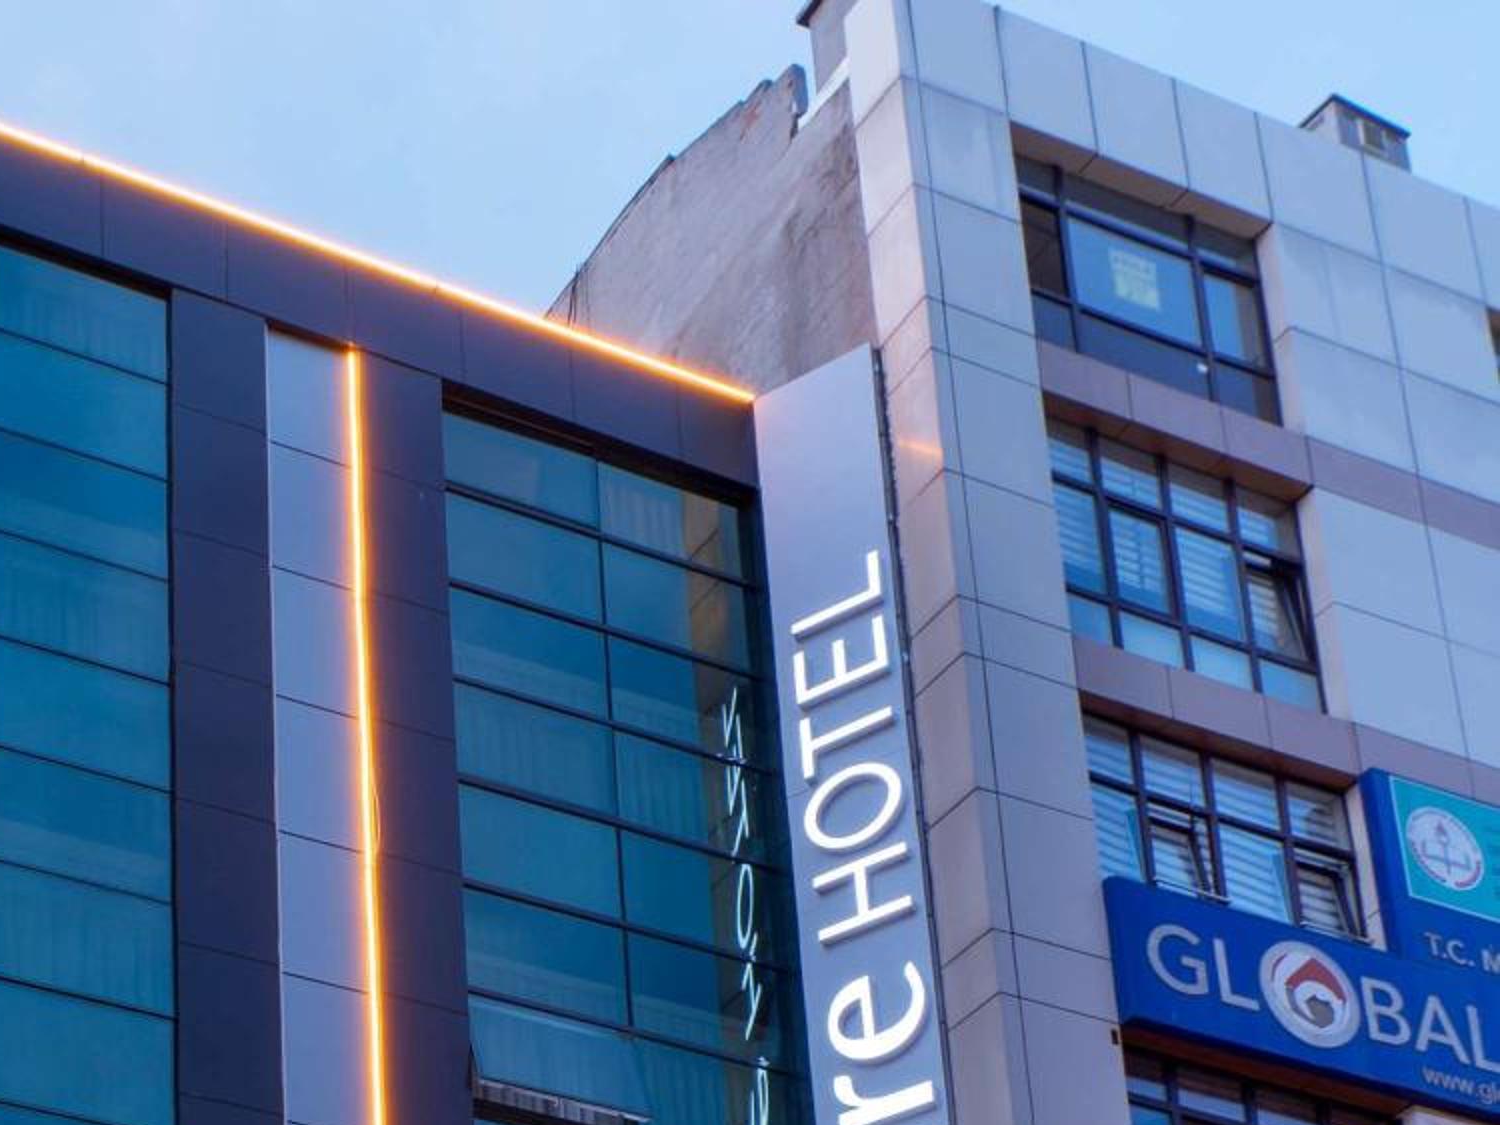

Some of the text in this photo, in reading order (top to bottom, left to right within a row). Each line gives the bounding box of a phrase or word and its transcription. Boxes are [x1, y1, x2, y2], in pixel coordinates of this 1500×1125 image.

[791, 549, 913, 945] HOTEL
[1146, 923, 1500, 1074] GLOBAL
[1424, 930, 1477, 968] T.C.
